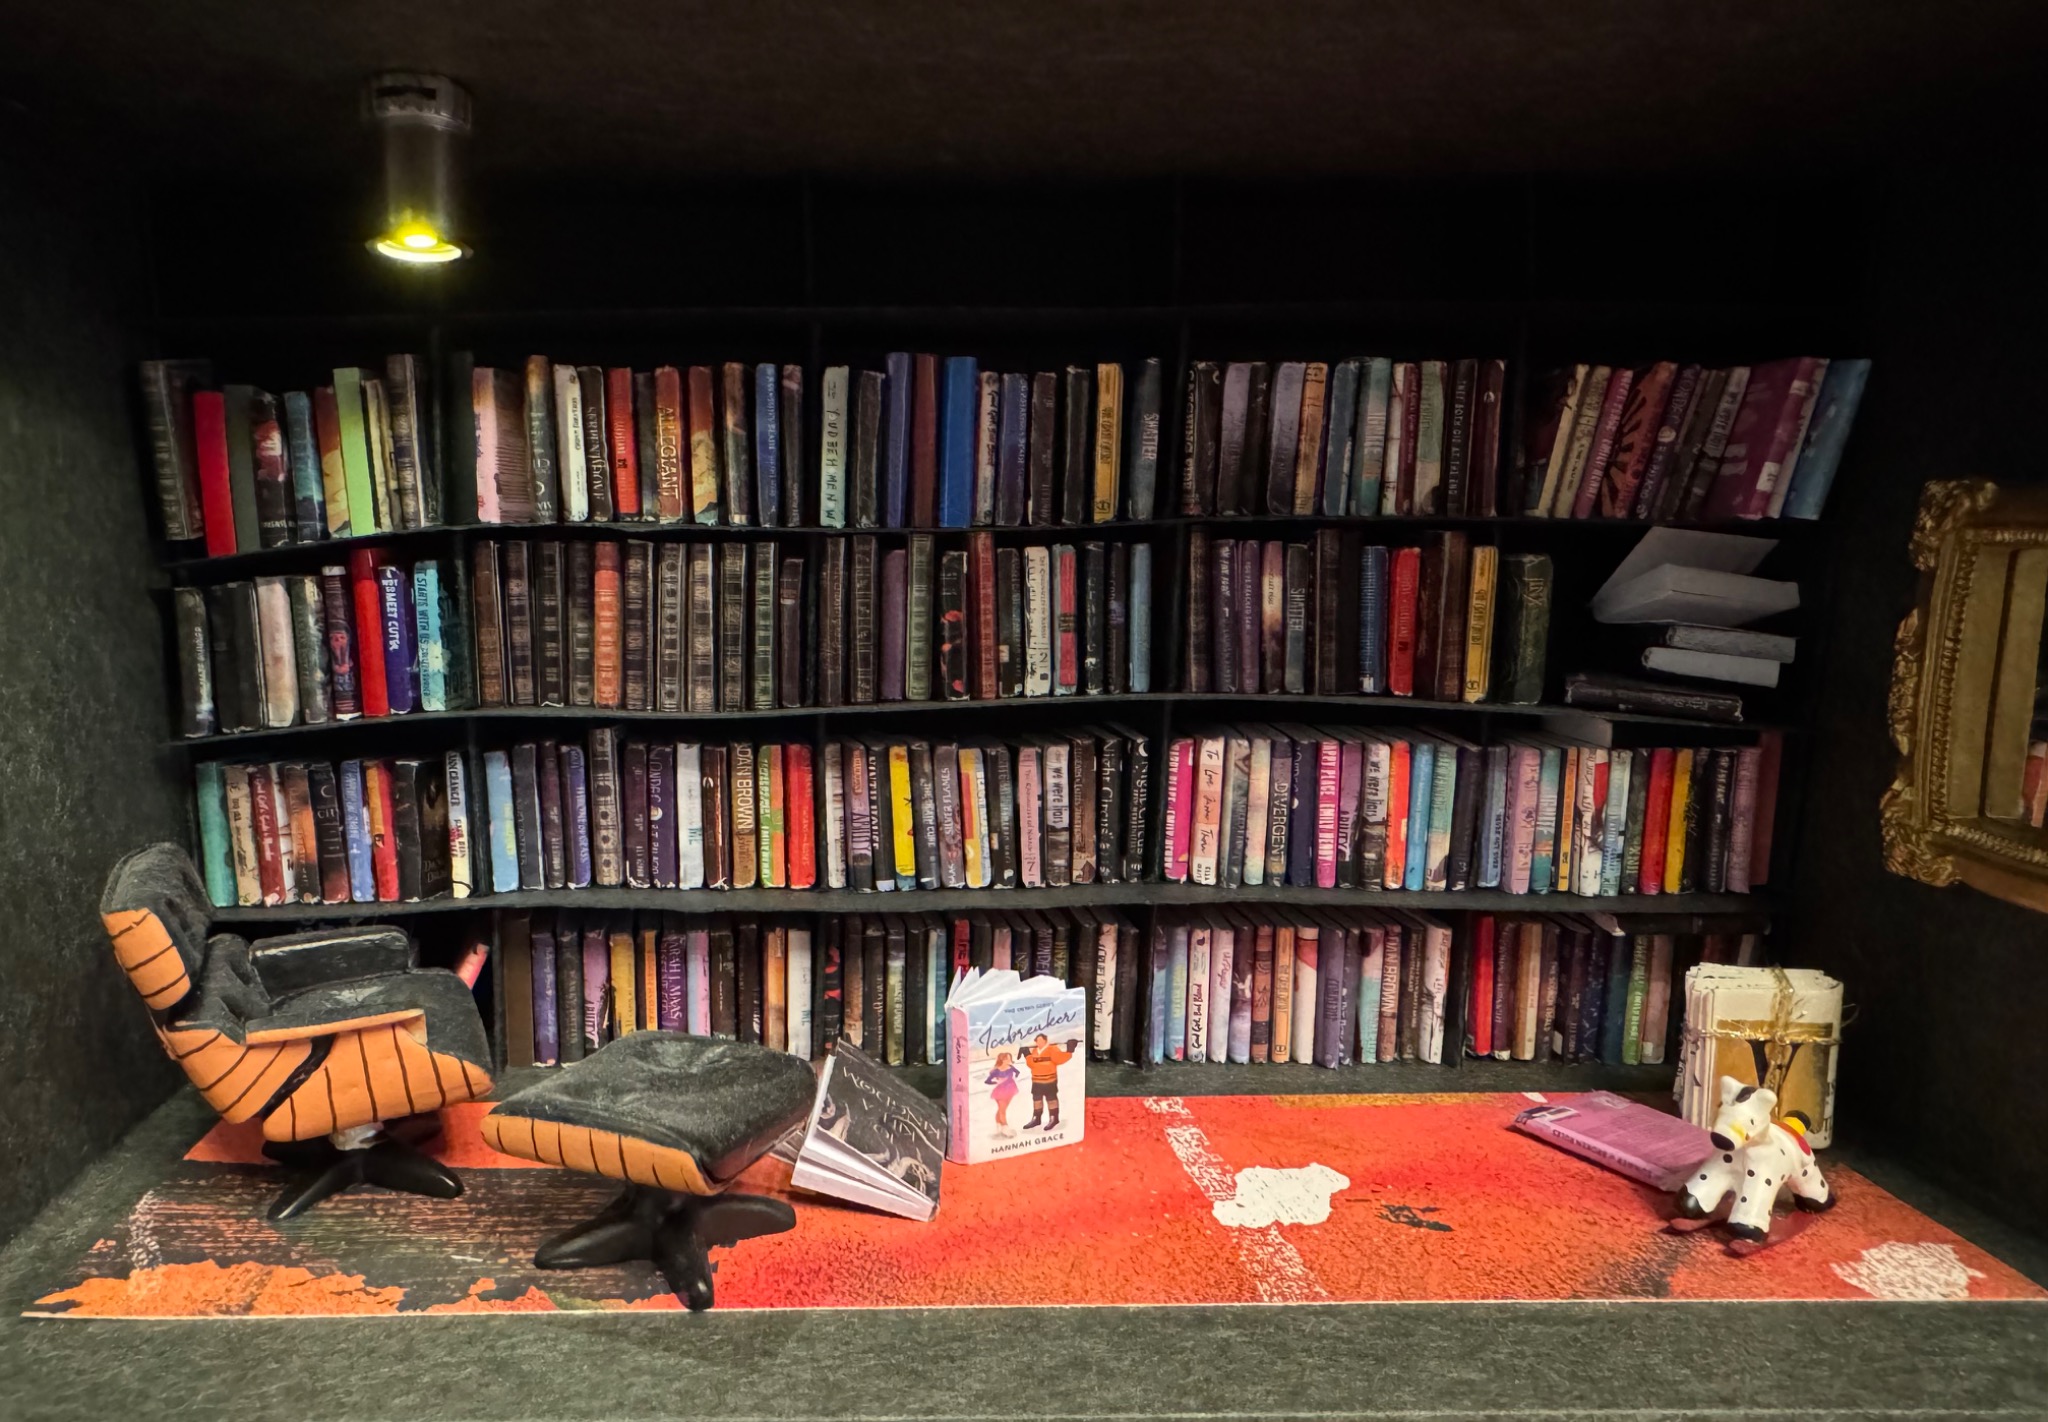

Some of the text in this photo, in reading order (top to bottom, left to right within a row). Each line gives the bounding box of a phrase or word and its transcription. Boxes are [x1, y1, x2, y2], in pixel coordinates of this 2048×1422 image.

[1183, 369, 1196, 453] CATCHING
[1453, 403, 1465, 427] BOTH
[1141, 413, 1160, 461] SHATTER
[656, 407, 679, 500] ALLEGIANT
[385, 591, 398, 618] MEET
[416, 578, 428, 607] STARTS
[1522, 578, 1545, 607] JINX
[418, 609, 429, 631] WITH
[1288, 588, 1305, 632] SHATTER
[419, 633, 430, 644] US
[736, 748, 753, 776] DAN
[1207, 749, 1219, 760] To
[940, 767, 950, 804] FLAMES
[1100, 740, 1117, 835] Night Circus
[1204, 769, 1218, 787] Love
[1320, 769, 1336, 796] PLACE
[1365, 761, 1384, 817] we were liars
[737, 778, 753, 830] BROWN
[1052, 766, 1069, 824] we were liars
[1136, 761, 1149, 855] Night Circus
[943, 805, 954, 836] SILVER
[1270, 782, 1289, 865] DIVERGENT
[1318, 803, 1335, 830] EMILY
[1318, 832, 1335, 861] HENRY
[1381, 936, 1399, 1013] DAN BROWN
[669, 984, 683, 1020] MAAS
[1192, 983, 1203, 1003] Blood
[893, 1003, 903, 1034] RUNNER
[1193, 1004, 1202, 1017] Bad
[979, 1008, 1076, 1056] Icebreaker
[1192, 1033, 1202, 1049] Good
[843, 1066, 940, 1140] KINGDOM
[991, 1133, 1064, 1154] HANNAH GRACE
